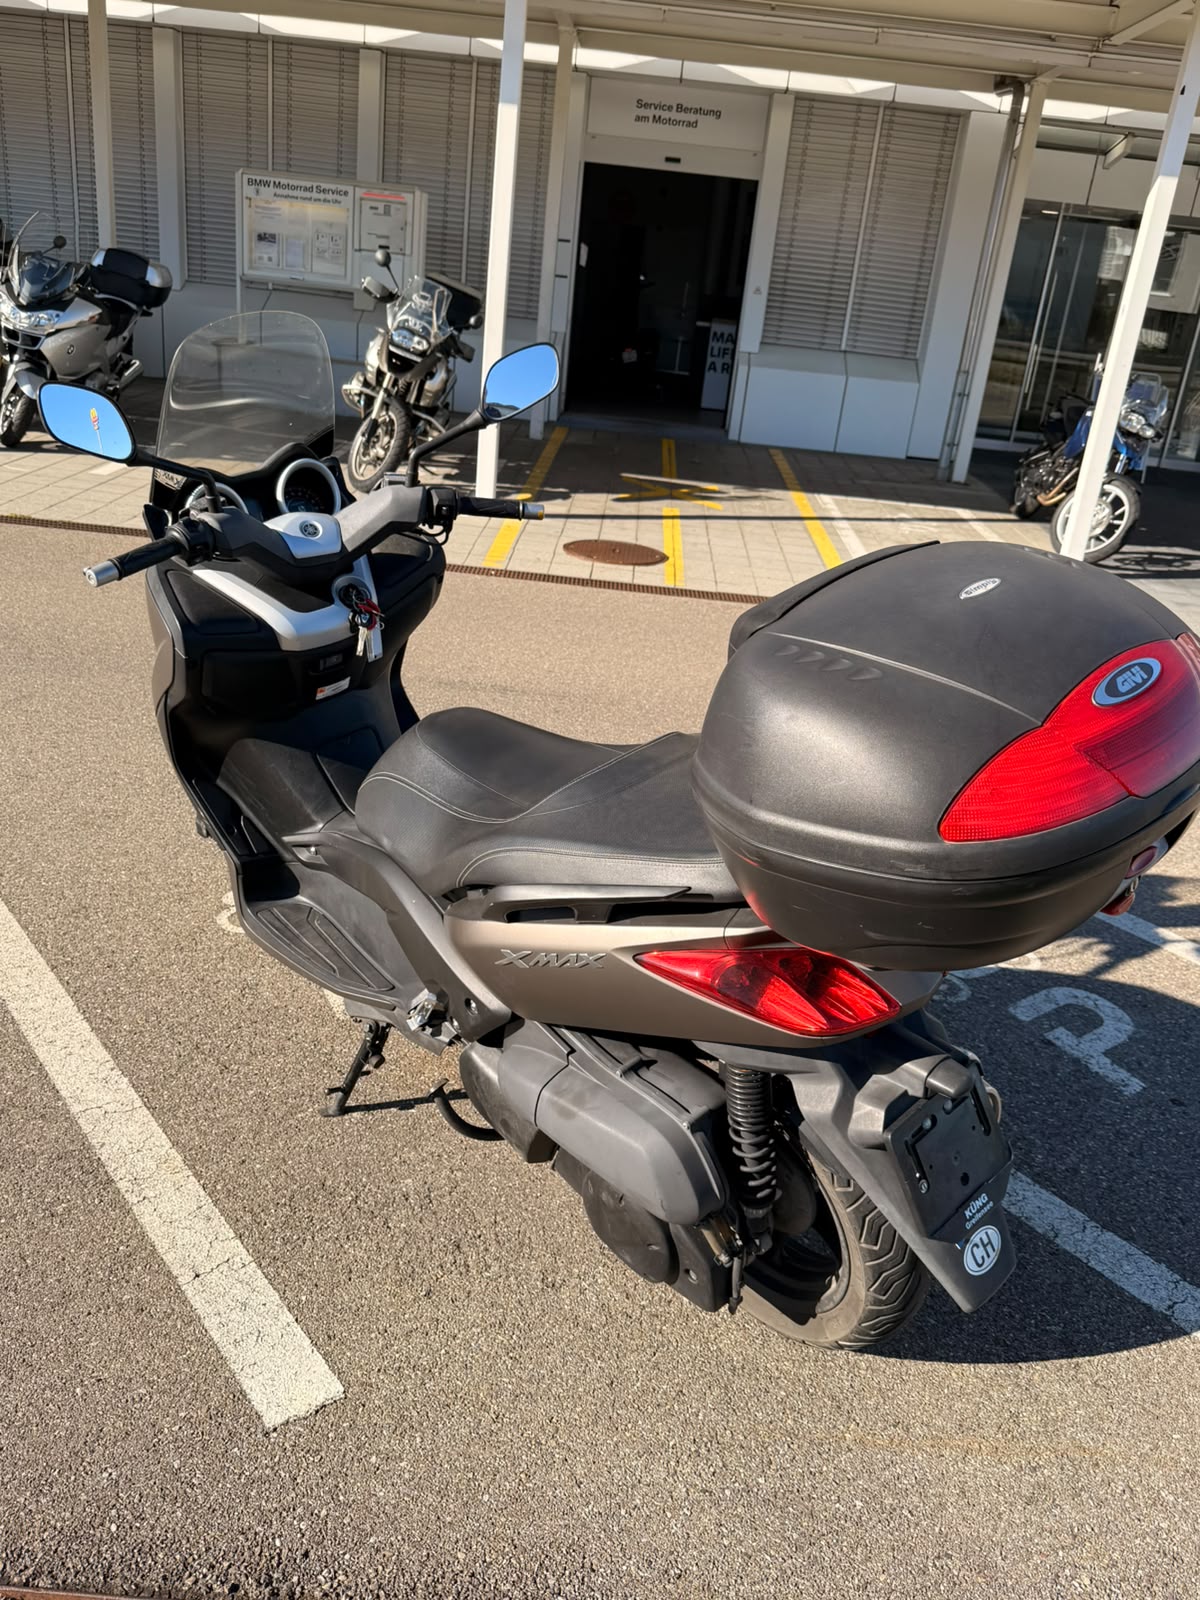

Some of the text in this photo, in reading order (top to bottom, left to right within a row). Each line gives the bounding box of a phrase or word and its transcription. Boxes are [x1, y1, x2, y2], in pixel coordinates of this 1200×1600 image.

[635, 98, 722, 120] Service Beratung
[634, 114, 699, 128] am Motorrad
[247, 177, 349, 197] BMW Motorrad Service
[273, 191, 299, 200] Annahme
[707, 361, 718, 373] A
[1115, 665, 1149, 693] GIVI
[964, 1193, 989, 1219] KÜNG
[970, 1231, 996, 1269] CH
